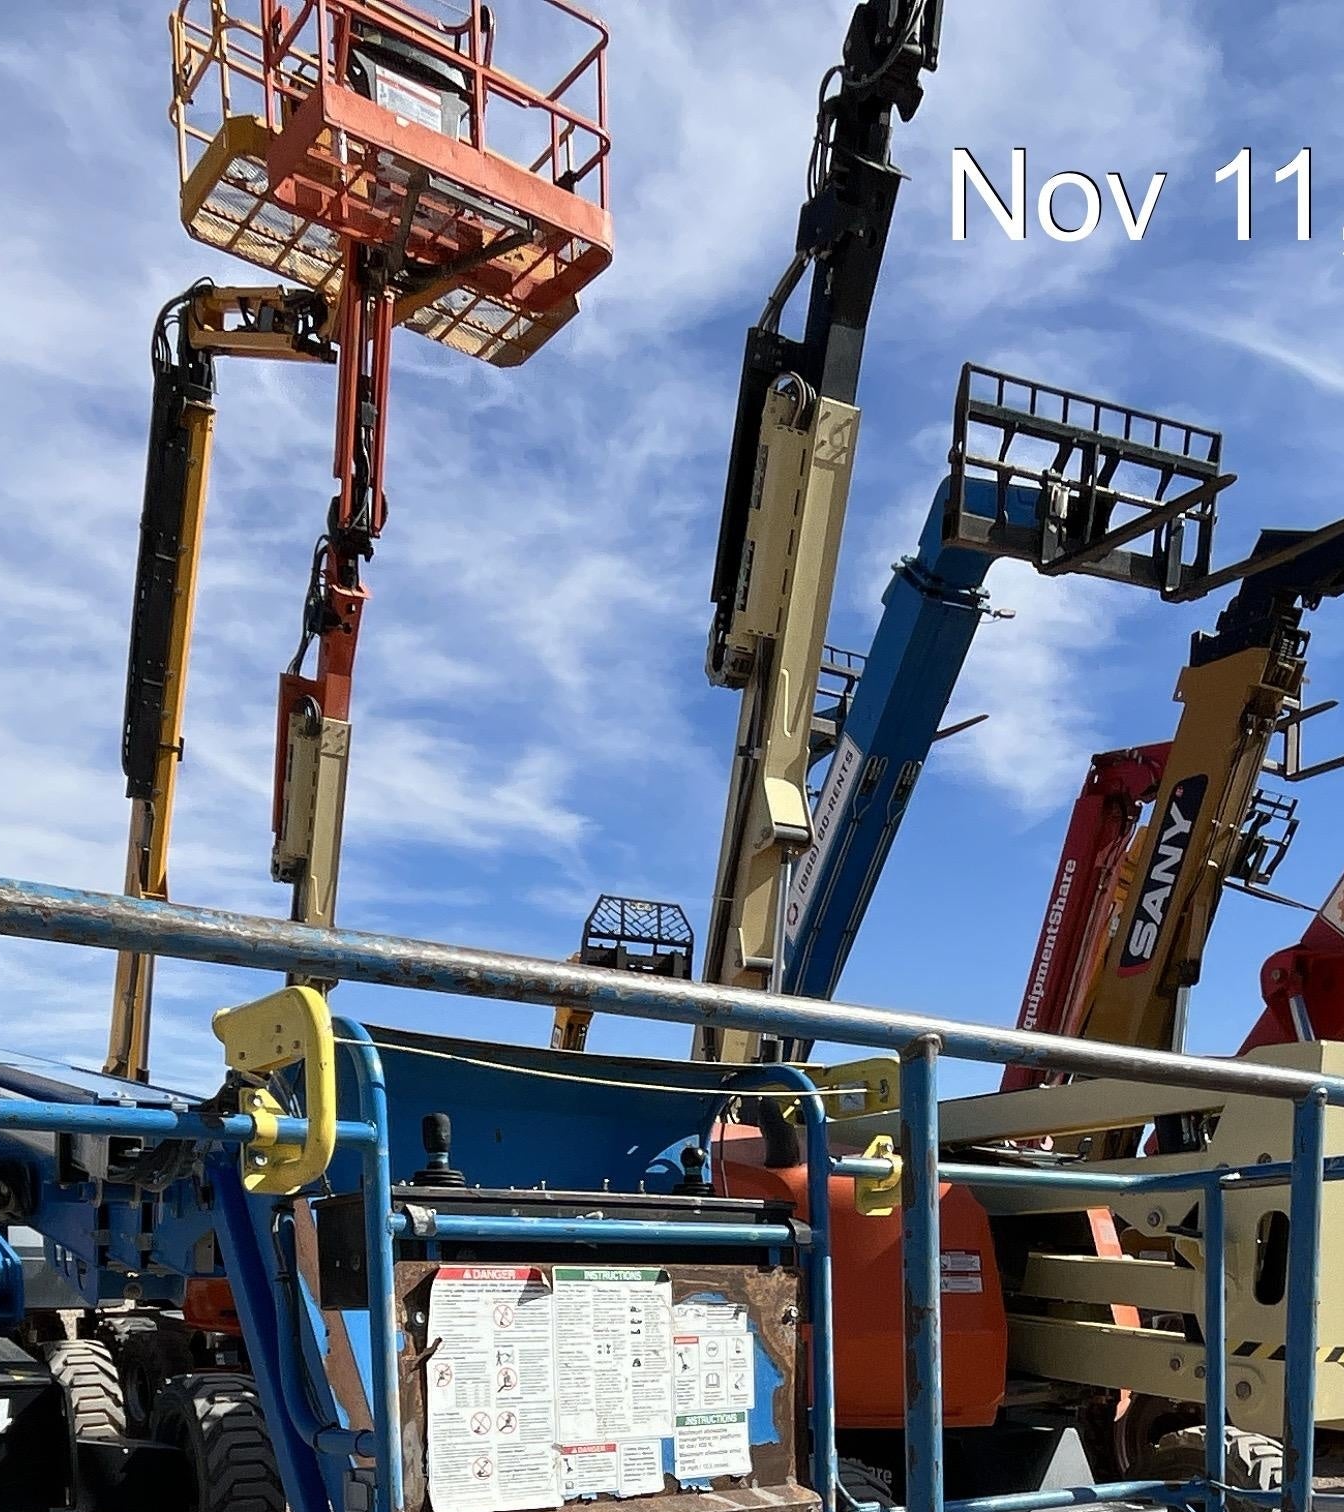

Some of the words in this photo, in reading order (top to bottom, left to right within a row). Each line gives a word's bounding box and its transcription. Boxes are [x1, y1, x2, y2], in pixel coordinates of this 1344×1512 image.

[1128, 801, 1192, 960] SANY
[1023, 858, 1077, 1030] quipmentShare
[472, 1269, 516, 1280] DANGER
[583, 1270, 643, 1281] INSTRUCTIONS
[684, 1413, 737, 1426] INSTRUCTIONS
